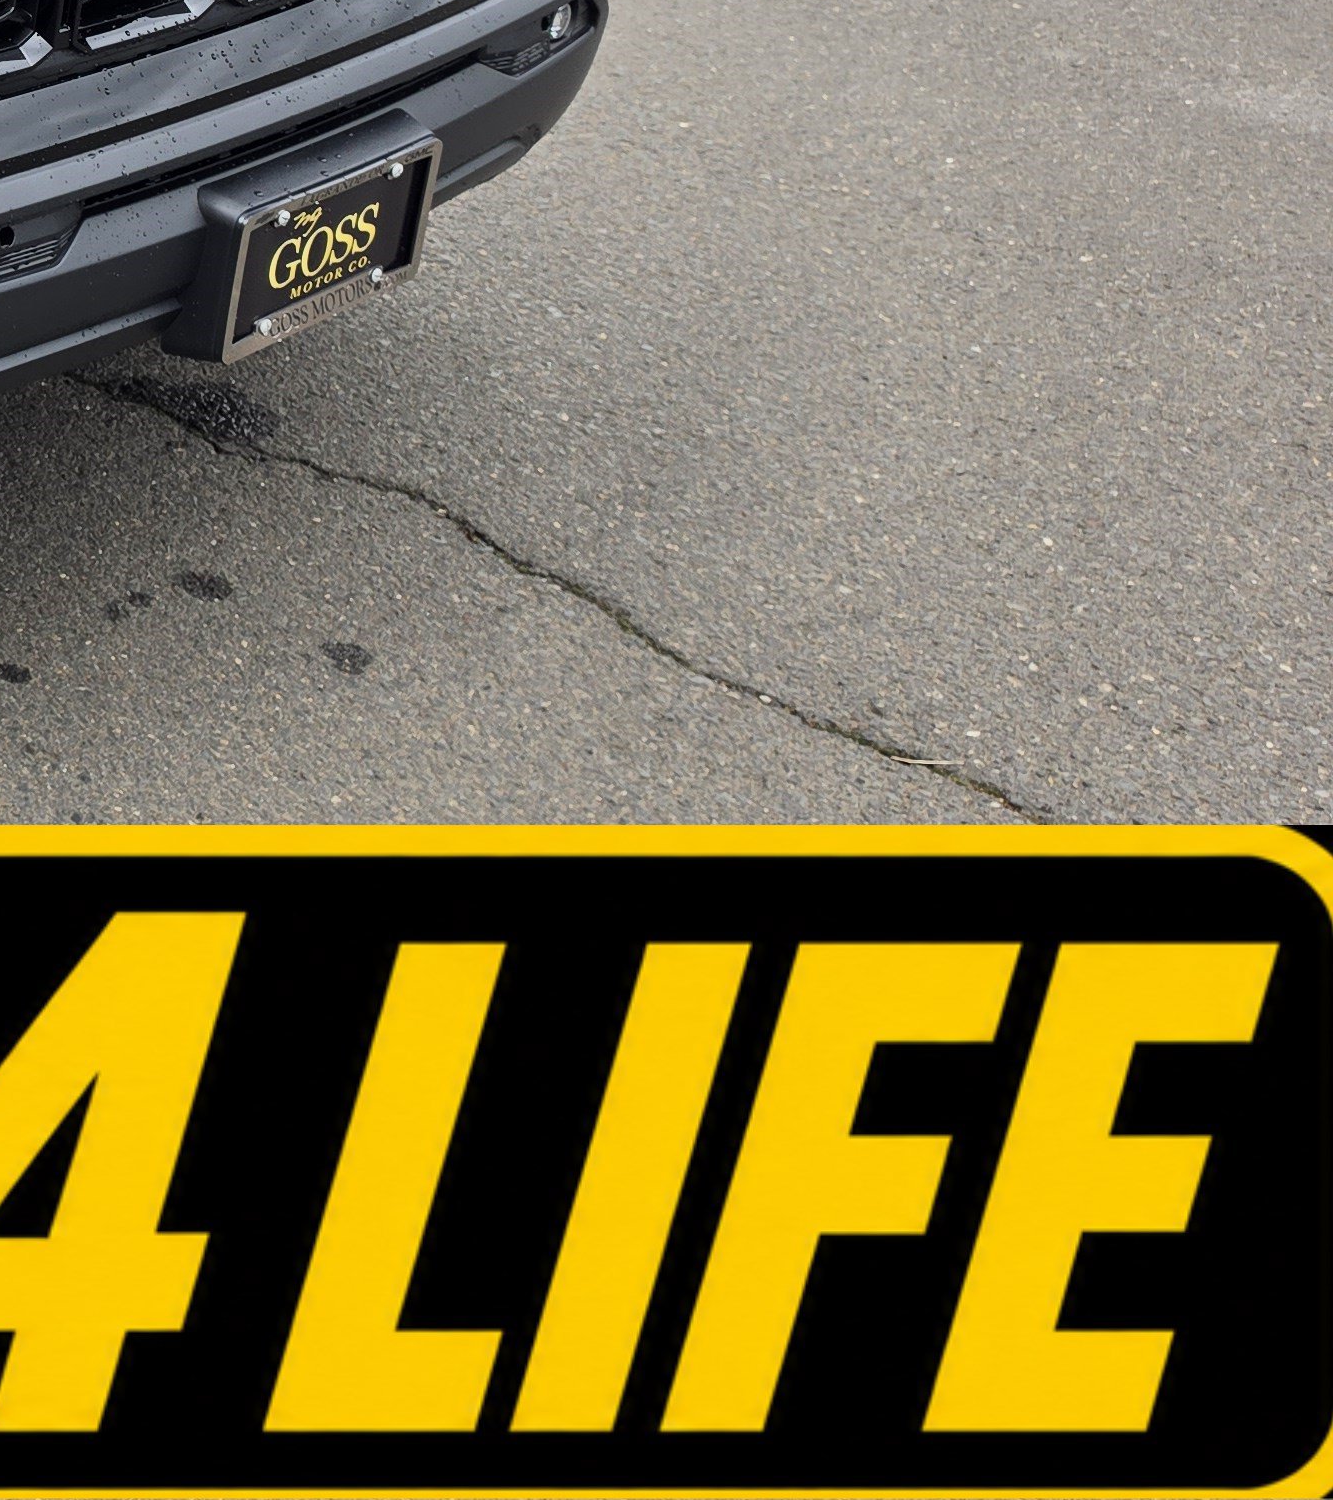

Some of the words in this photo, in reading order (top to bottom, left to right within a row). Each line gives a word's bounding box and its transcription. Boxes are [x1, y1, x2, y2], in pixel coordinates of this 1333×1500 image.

[268, 202, 380, 289] GOSS
[290, 268, 343, 299] MOTOR
[348, 255, 371, 274] CO.
[270, 304, 310, 337] GOSS
[312, 278, 372, 320] MOTORS
